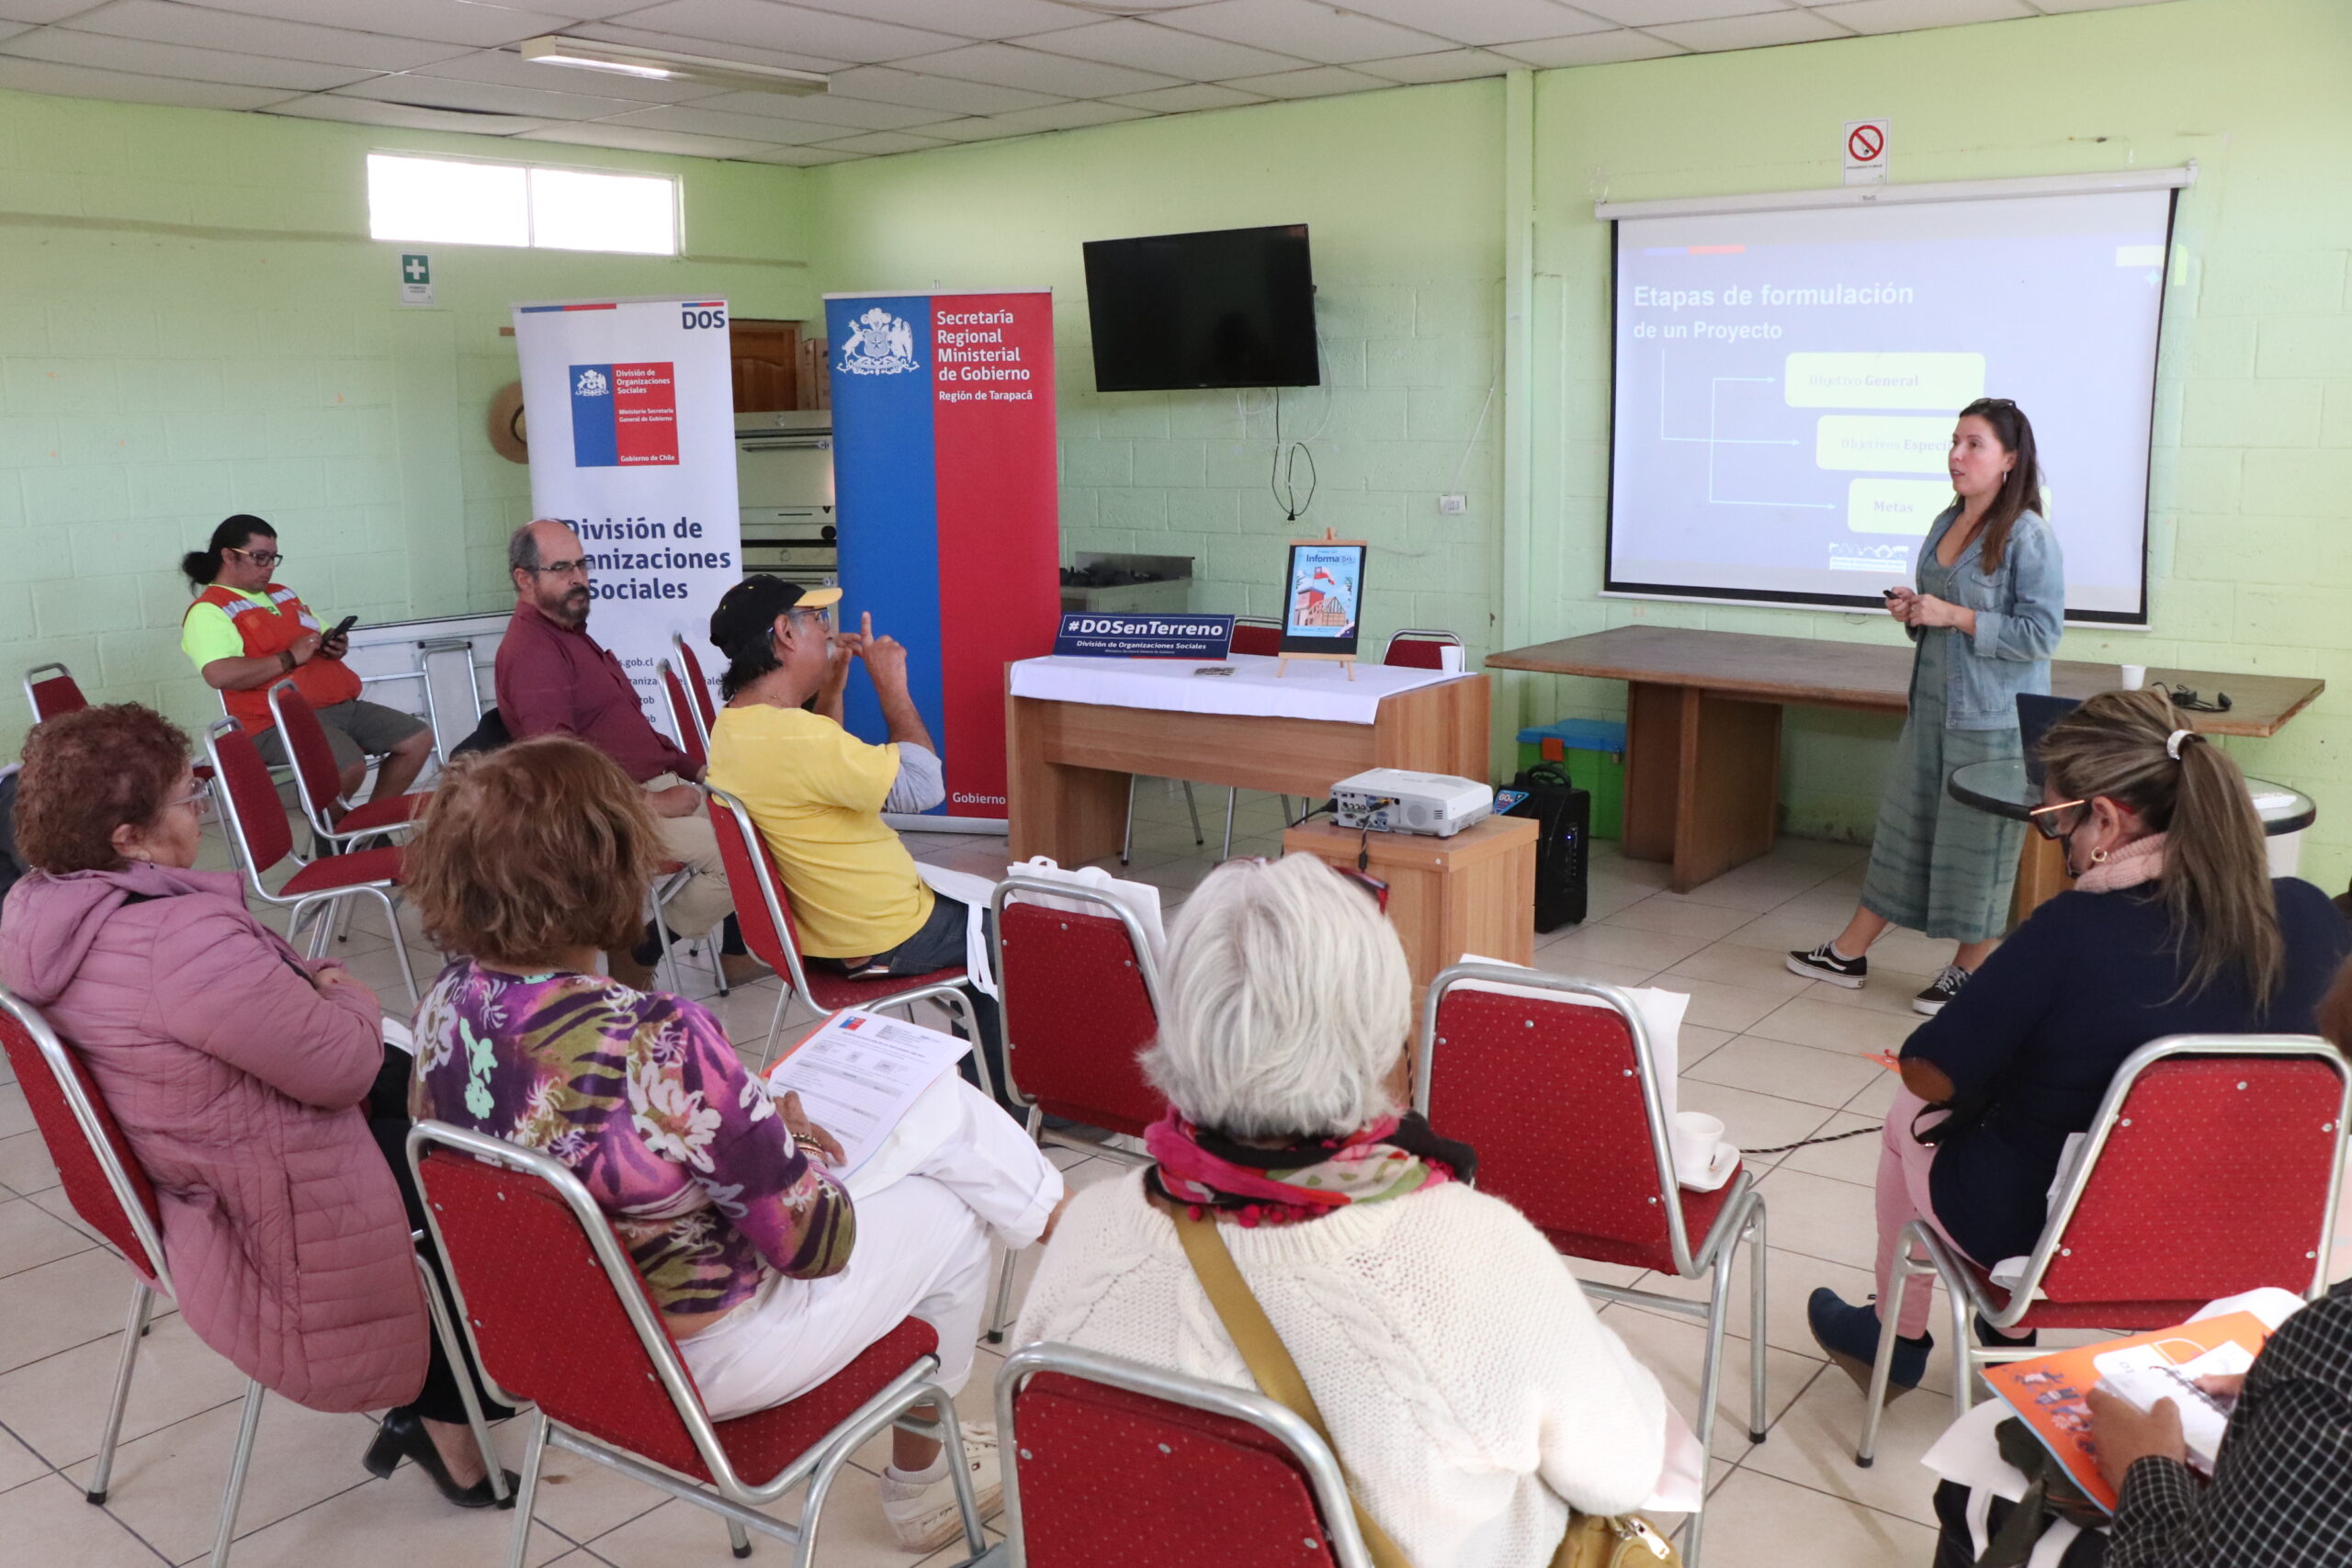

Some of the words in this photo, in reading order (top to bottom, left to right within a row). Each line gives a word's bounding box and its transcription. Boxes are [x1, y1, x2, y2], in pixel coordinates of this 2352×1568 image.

[1633, 285, 1715, 312] Etapas
[1723, 284, 1753, 307] de
[1760, 282, 1915, 306] formulación
[682, 310, 726, 330] DOS
[936, 309, 1014, 326] Secretaría
[937, 328, 1003, 347] Regional
[1633, 321, 1657, 339] de
[1663, 323, 1688, 339] un
[1693, 321, 1783, 344] Proyecto
[937, 347, 1022, 363] Ministerial
[616, 368, 646, 378] División
[938, 367, 957, 381] de
[960, 366, 1031, 381] Gobierno
[616, 378, 671, 387] Organizaciones
[1864, 374, 1920, 388] General
[616, 387, 648, 395] Sociales
[938, 389, 973, 403] Región
[975, 390, 988, 400] de
[989, 389, 1033, 402] Tarapacá
[1873, 500, 1915, 513] Metas
[673, 516, 703, 538] de
[584, 547, 731, 570] anizaciones
[1306, 554, 1340, 563] Informa
[587, 577, 688, 601] Sociales
[1068, 618, 1224, 637] #DOSenTerreno
[1076, 639, 1107, 648] División
[1118, 641, 1174, 649] Organizaciones
[952, 791, 1007, 805] Gobierno
